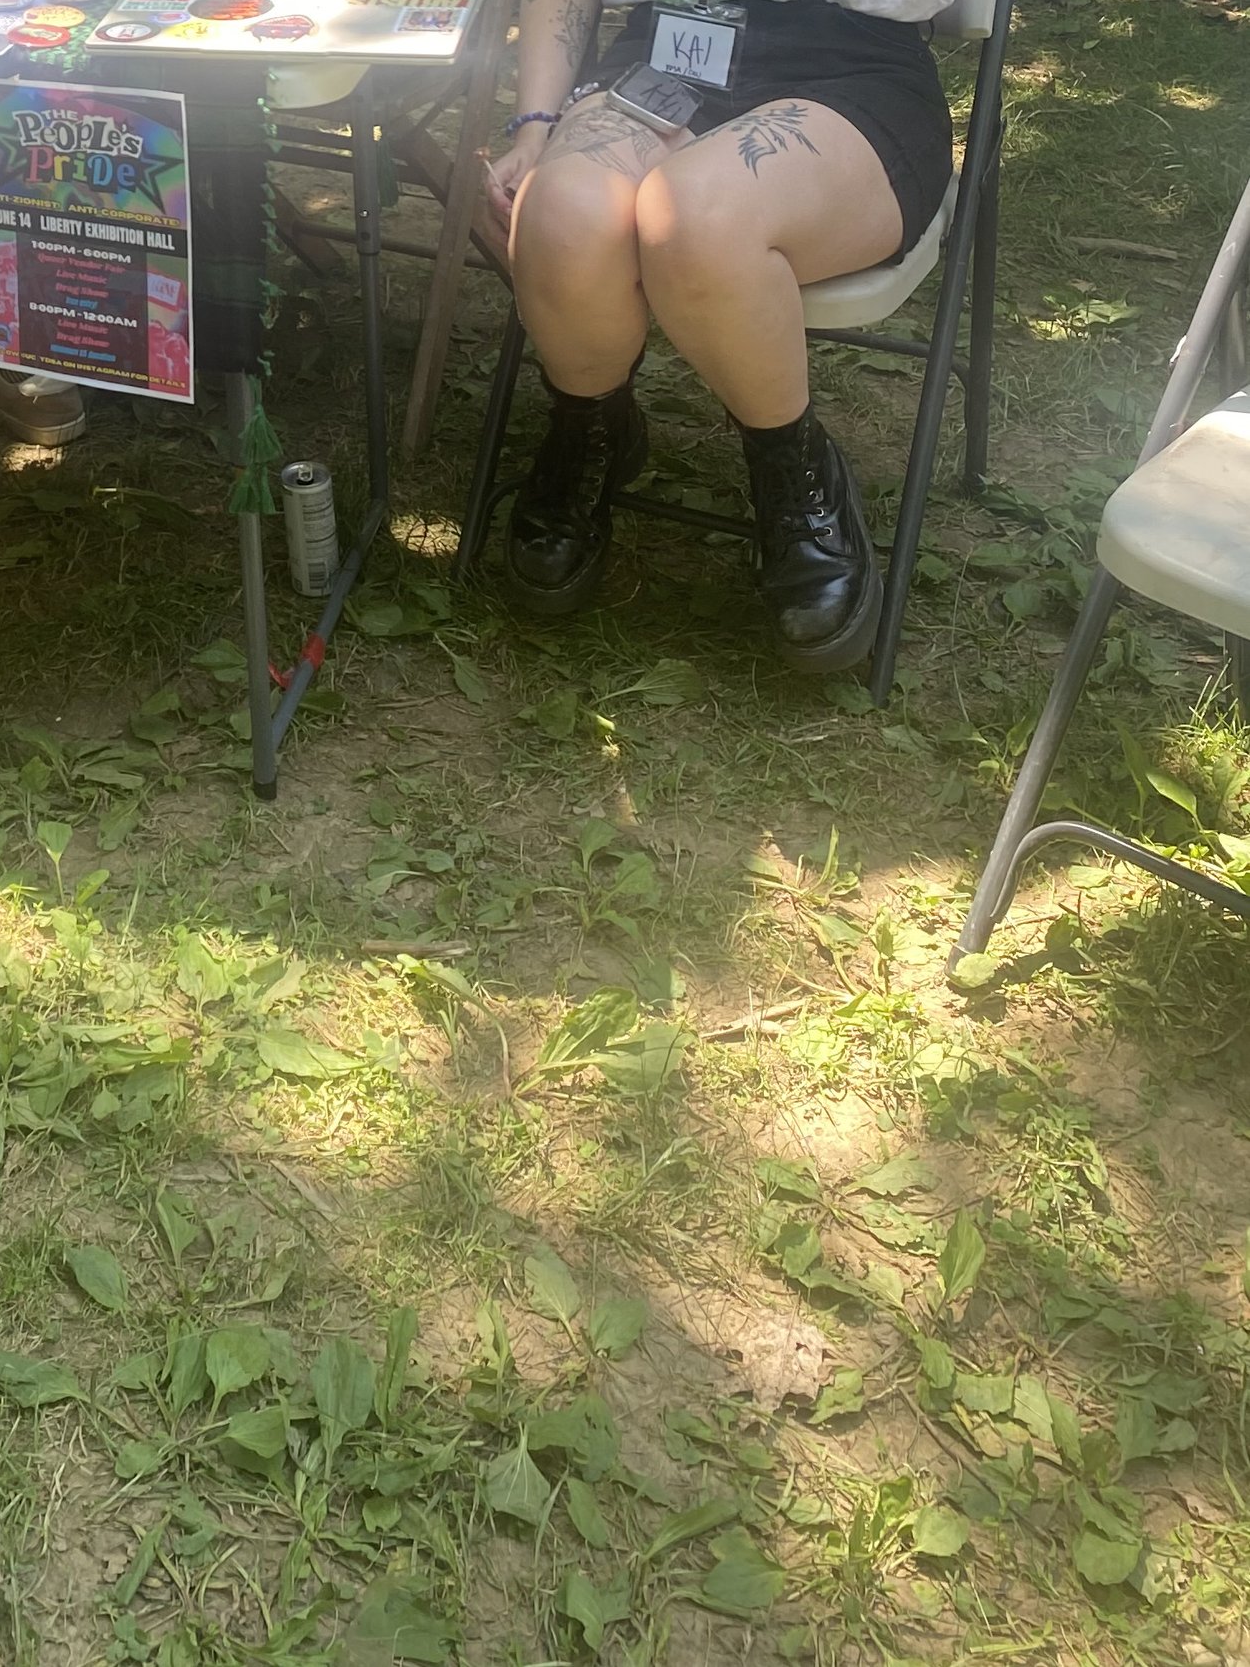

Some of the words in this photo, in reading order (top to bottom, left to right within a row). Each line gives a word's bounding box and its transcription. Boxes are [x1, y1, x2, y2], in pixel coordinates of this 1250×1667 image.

[673, 31, 712, 69] KAI
[45, 109, 79, 121] THE
[18, 212, 32, 228] 14
[40, 215, 83, 237] LIBERTY
[85, 221, 144, 245] EXHIBITION
[146, 231, 176, 250] HALL
[76, 362, 130, 379] INSTAGRAM
